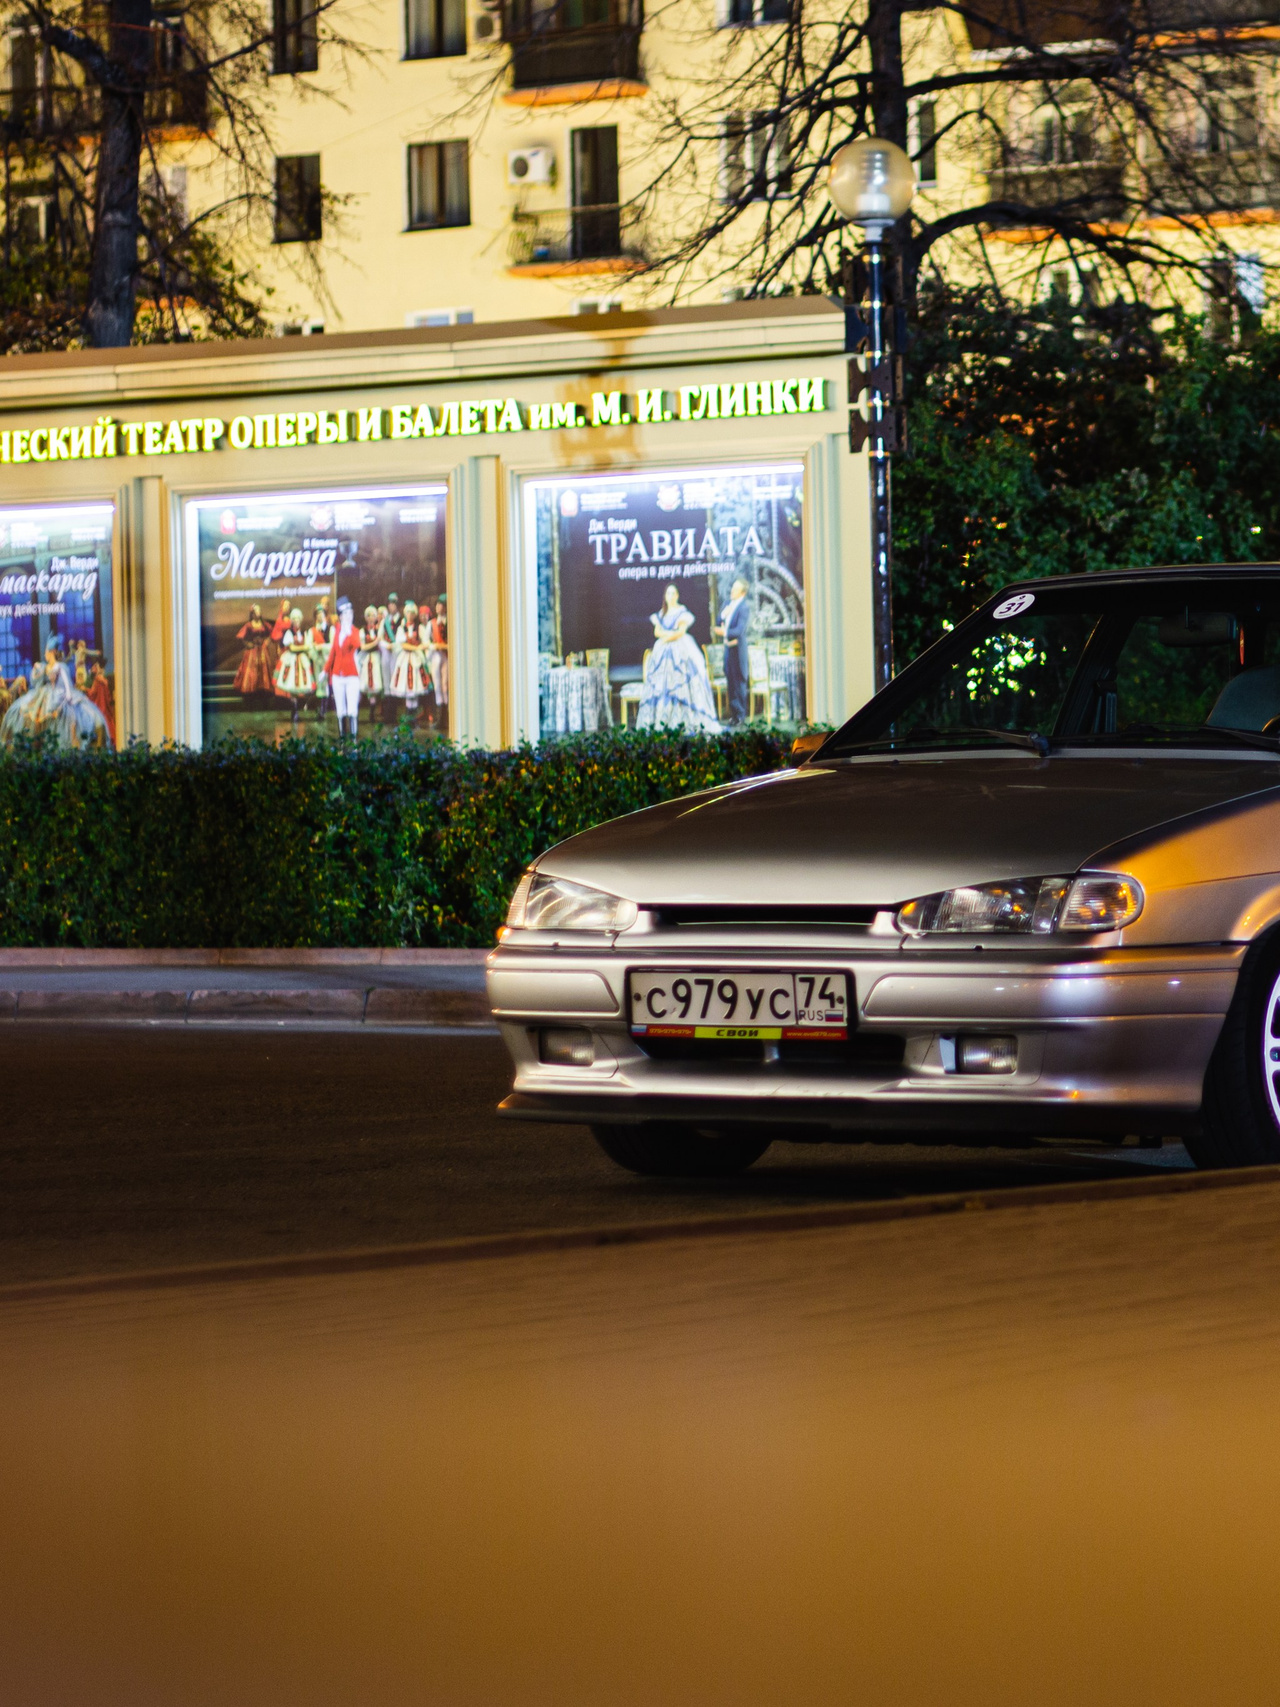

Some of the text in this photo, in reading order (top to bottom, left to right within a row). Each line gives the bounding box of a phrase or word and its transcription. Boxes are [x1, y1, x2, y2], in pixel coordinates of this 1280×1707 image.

[121, 418, 225, 456] ТЕАТР
[229, 409, 349, 450] ОПЕРЫ
[356, 407, 382, 441] И
[390, 398, 523, 439] БАЛЕТА
[529, 402, 586, 430] им.
[591, 390, 631, 427] М.
[636, 388, 673, 424] И.
[678, 377, 825, 421] ГЛИНКИ
[588, 517, 637, 534] Дж. Верди
[588, 526, 766, 565] ТРАВИАТА
[210, 541, 338, 587] Марица
[618, 561, 735, 581] опера в двух действиях
[0, 569, 98, 602] маскарад
[14, 600, 65, 619] действиях
[998, 601, 1026, 615] 31
[798, 977, 836, 1009] 74
[799, 1009, 824, 1021] RUS
